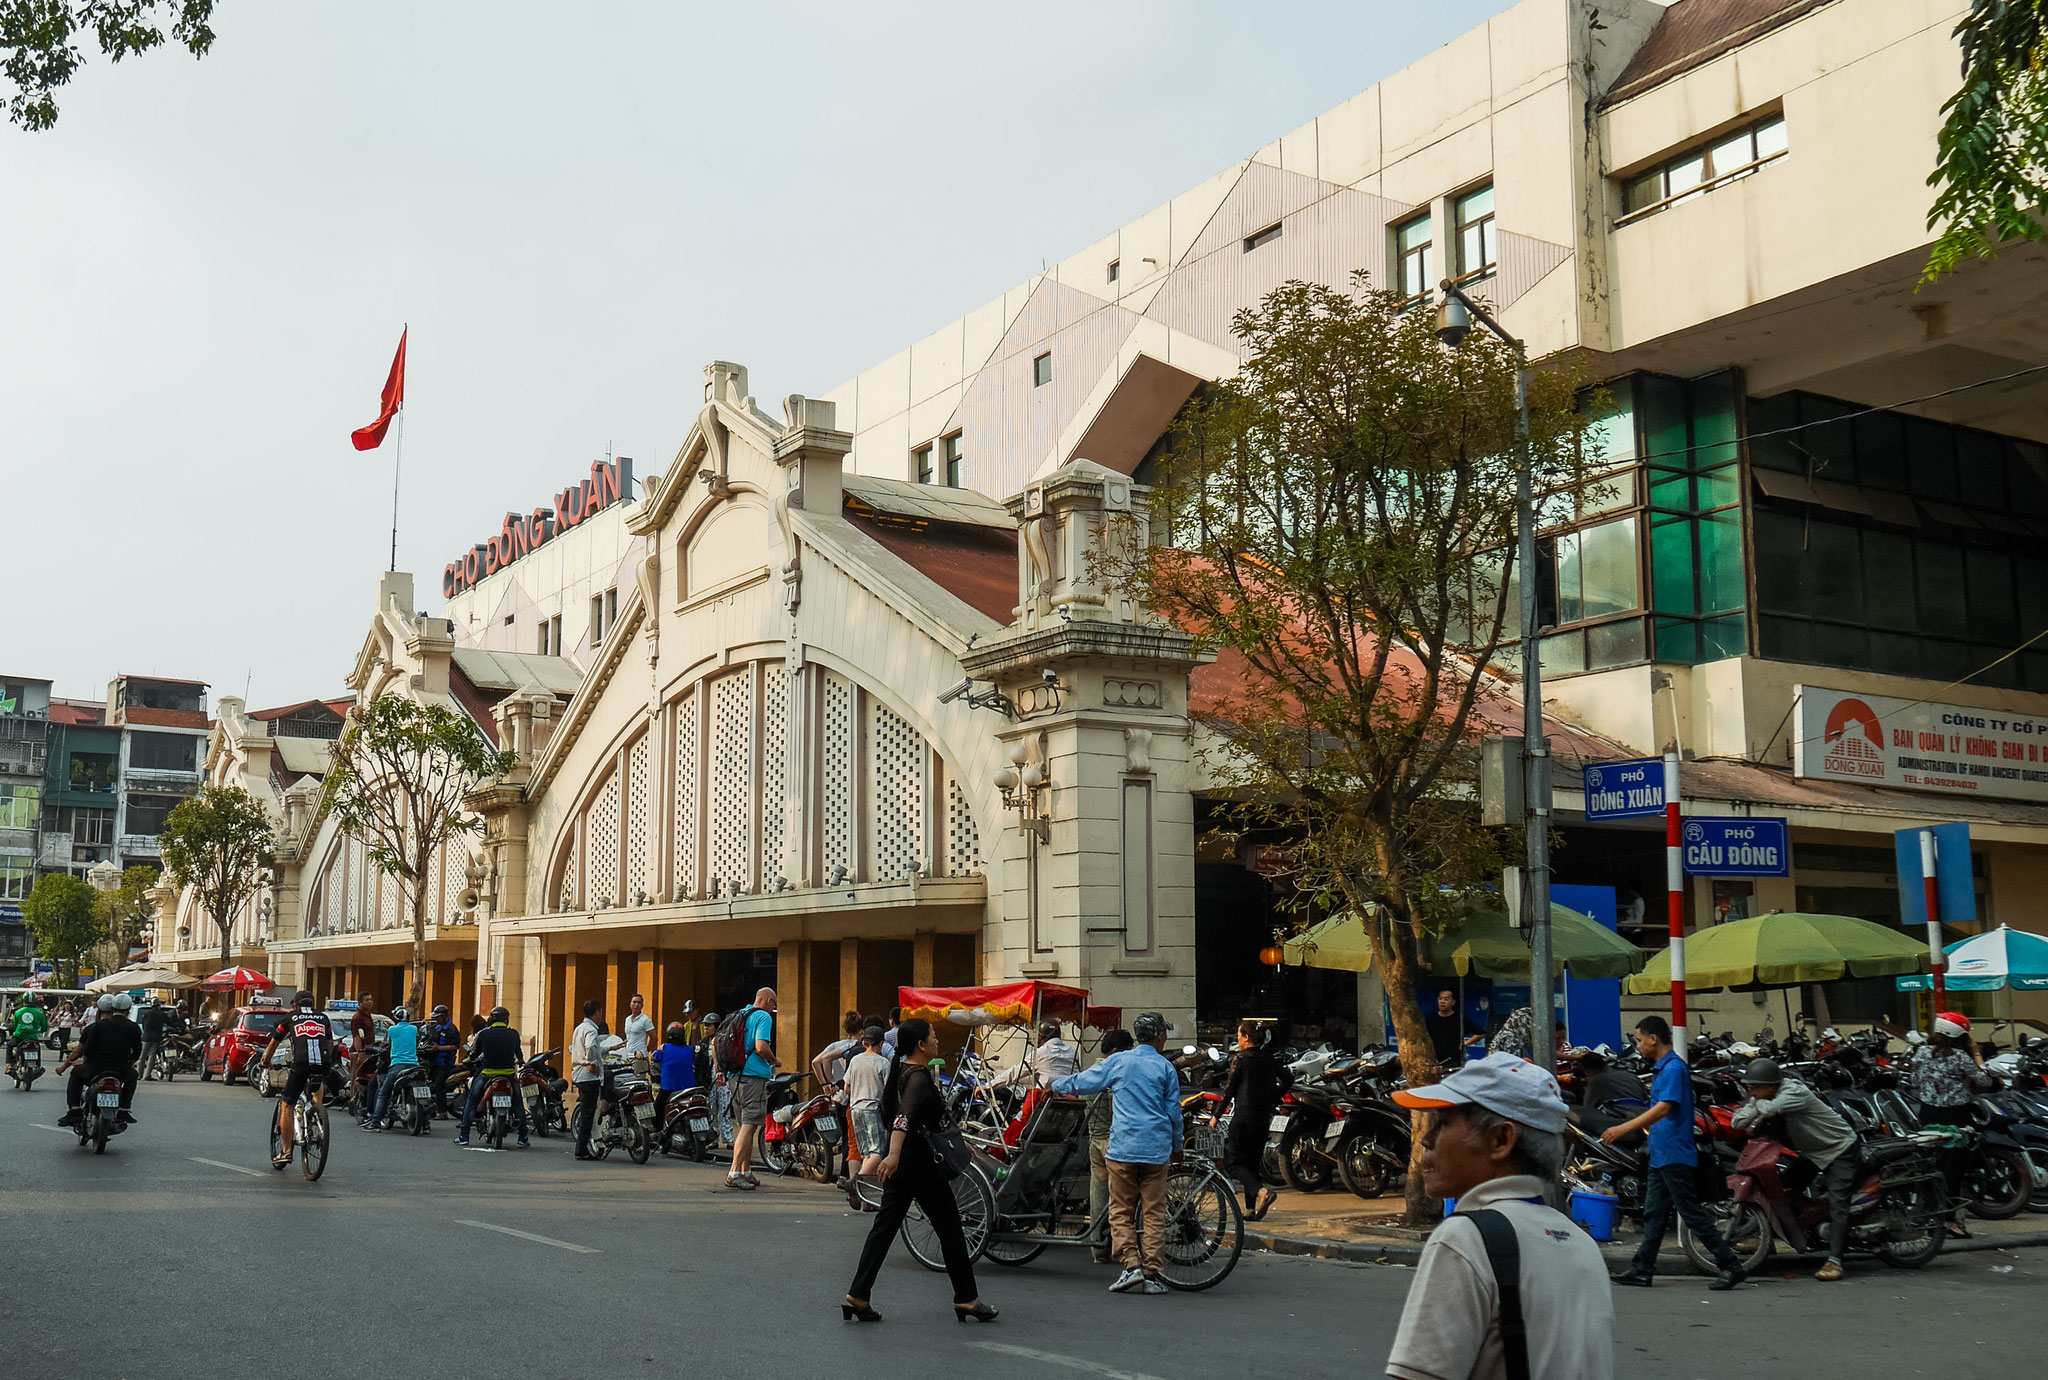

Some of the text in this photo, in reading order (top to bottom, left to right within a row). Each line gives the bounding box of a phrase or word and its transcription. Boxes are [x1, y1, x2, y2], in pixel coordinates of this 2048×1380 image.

[552, 456, 627, 537] XUÂN
[1942, 713, 1985, 728] CÔNG
[1990, 719, 2007, 731] TY
[1893, 729, 1913, 748] BAN
[1919, 726, 1945, 752] QUẢN
[1950, 733, 1960, 754] LÝ
[1966, 735, 1997, 758] KHÔNG
[2002, 741, 2024, 760] GIAN
[1621, 767, 1644, 782] PHỐ
[1825, 758, 1884, 776] DONG XUAN
[1898, 756, 1957, 774] ADMINISTRATION
[1959, 763, 1968, 775] OF
[1969, 764, 1990, 777] HANOI
[1992, 766, 2020, 780] ANCIENT
[1904, 775, 1922, 784] TEL:
[1591, 784, 1662, 812] ĐỒNG XUÂN
[1725, 826, 1755, 839] PHỐ
[1688, 840, 1778, 866] CẦU ĐÔNG
